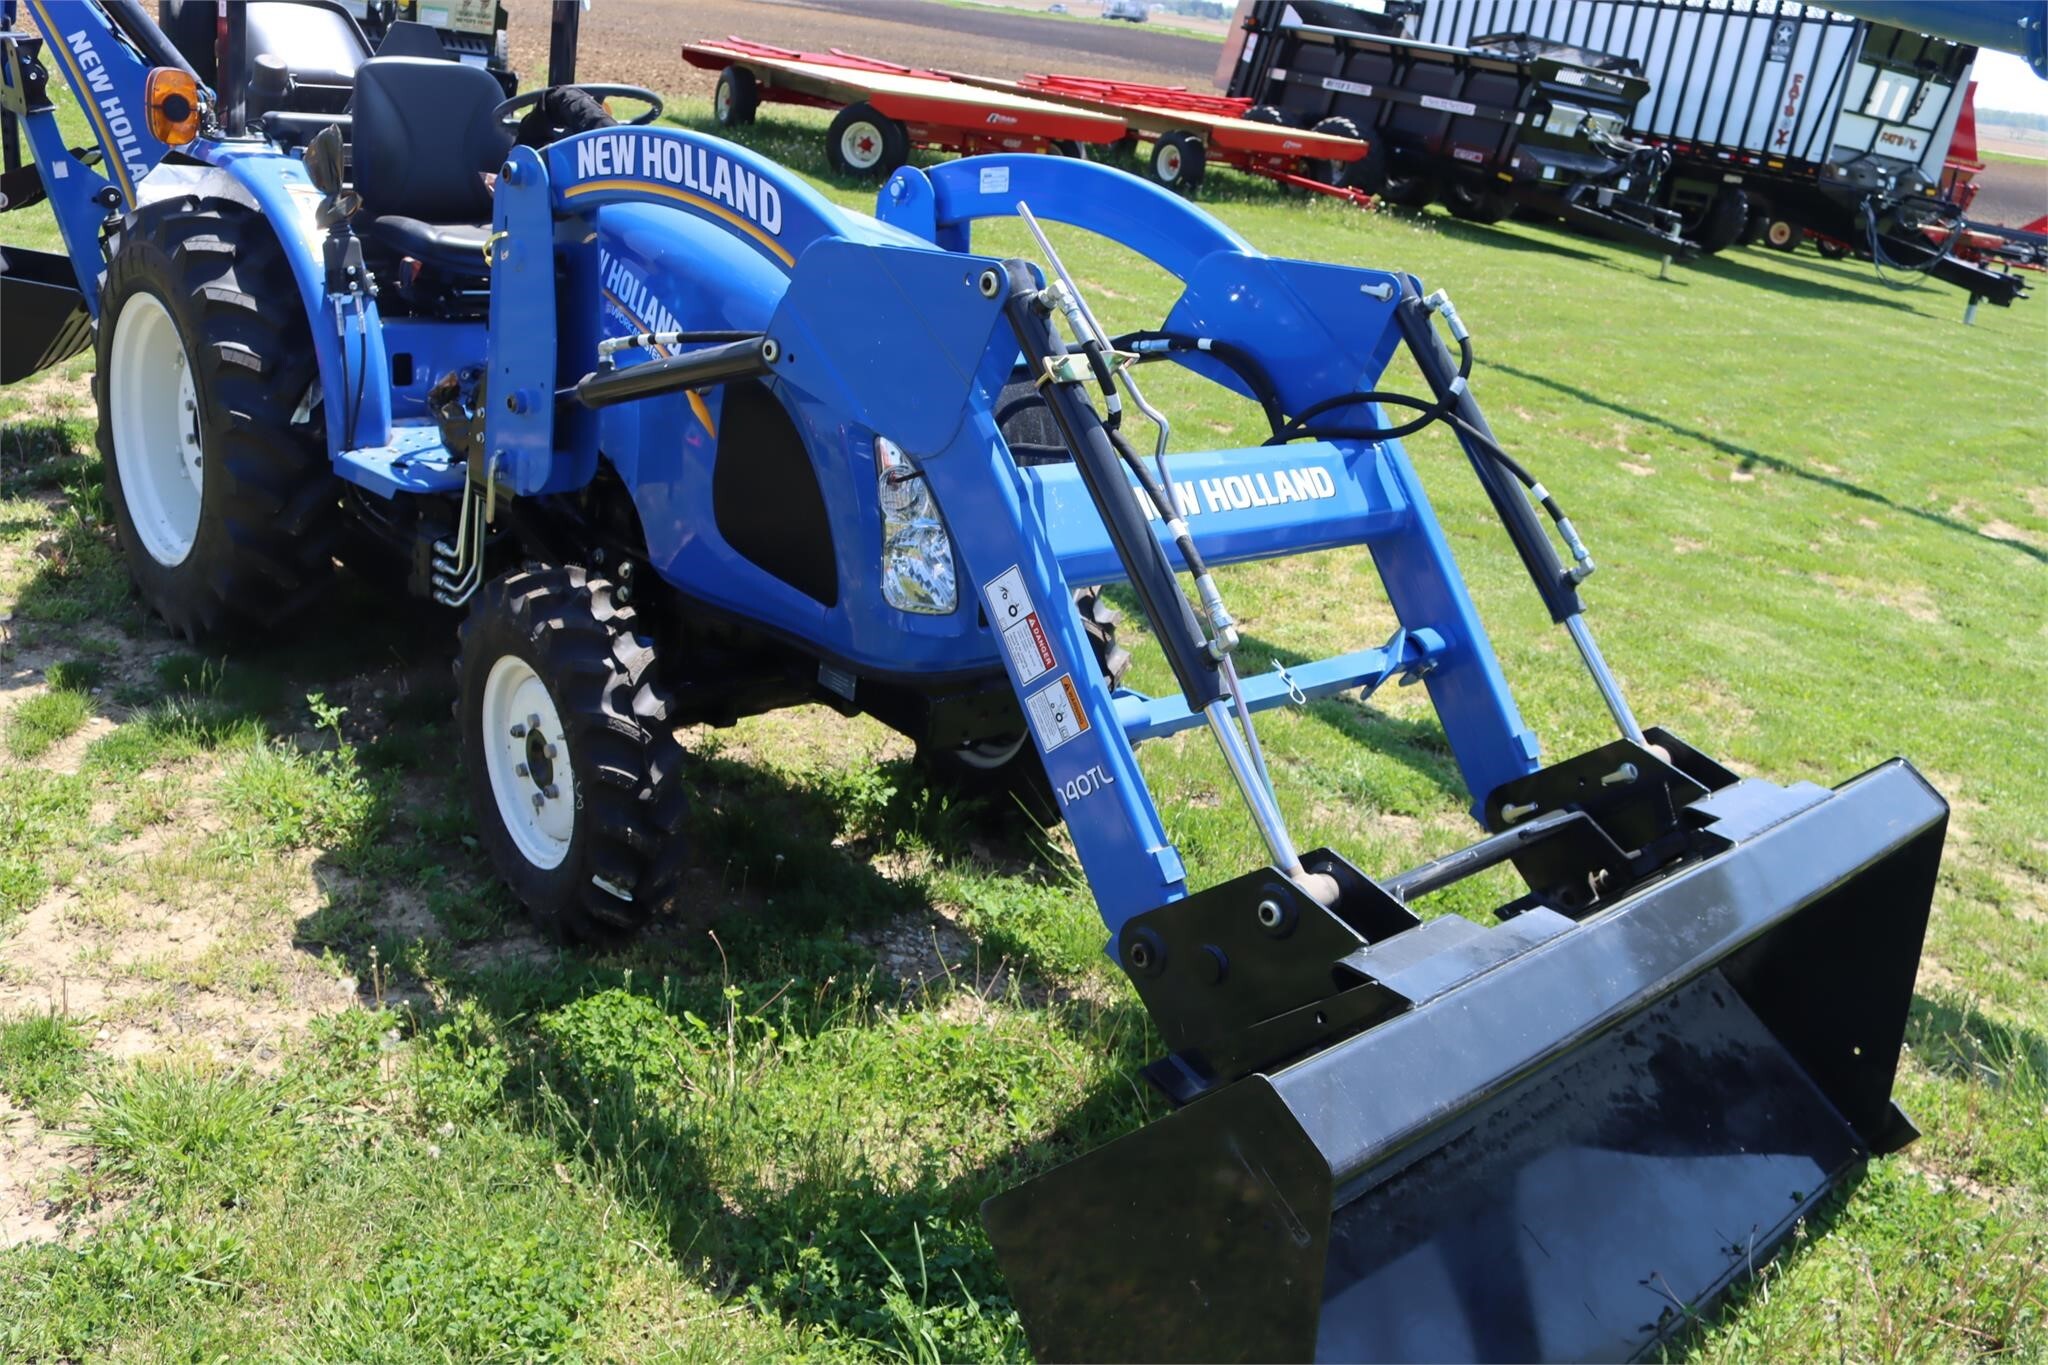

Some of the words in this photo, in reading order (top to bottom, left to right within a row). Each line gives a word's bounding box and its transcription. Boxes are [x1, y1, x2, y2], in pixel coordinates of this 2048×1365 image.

[66, 30, 114, 93] NEW
[100, 97, 150, 184] HOLLA
[577, 135, 635, 179] NEW
[642, 136, 782, 236] HOLLAND
[1199, 466, 1336, 513] HOLLAND
[1032, 627, 1052, 666] DANGER
[1056, 765, 1114, 806] 140TL
